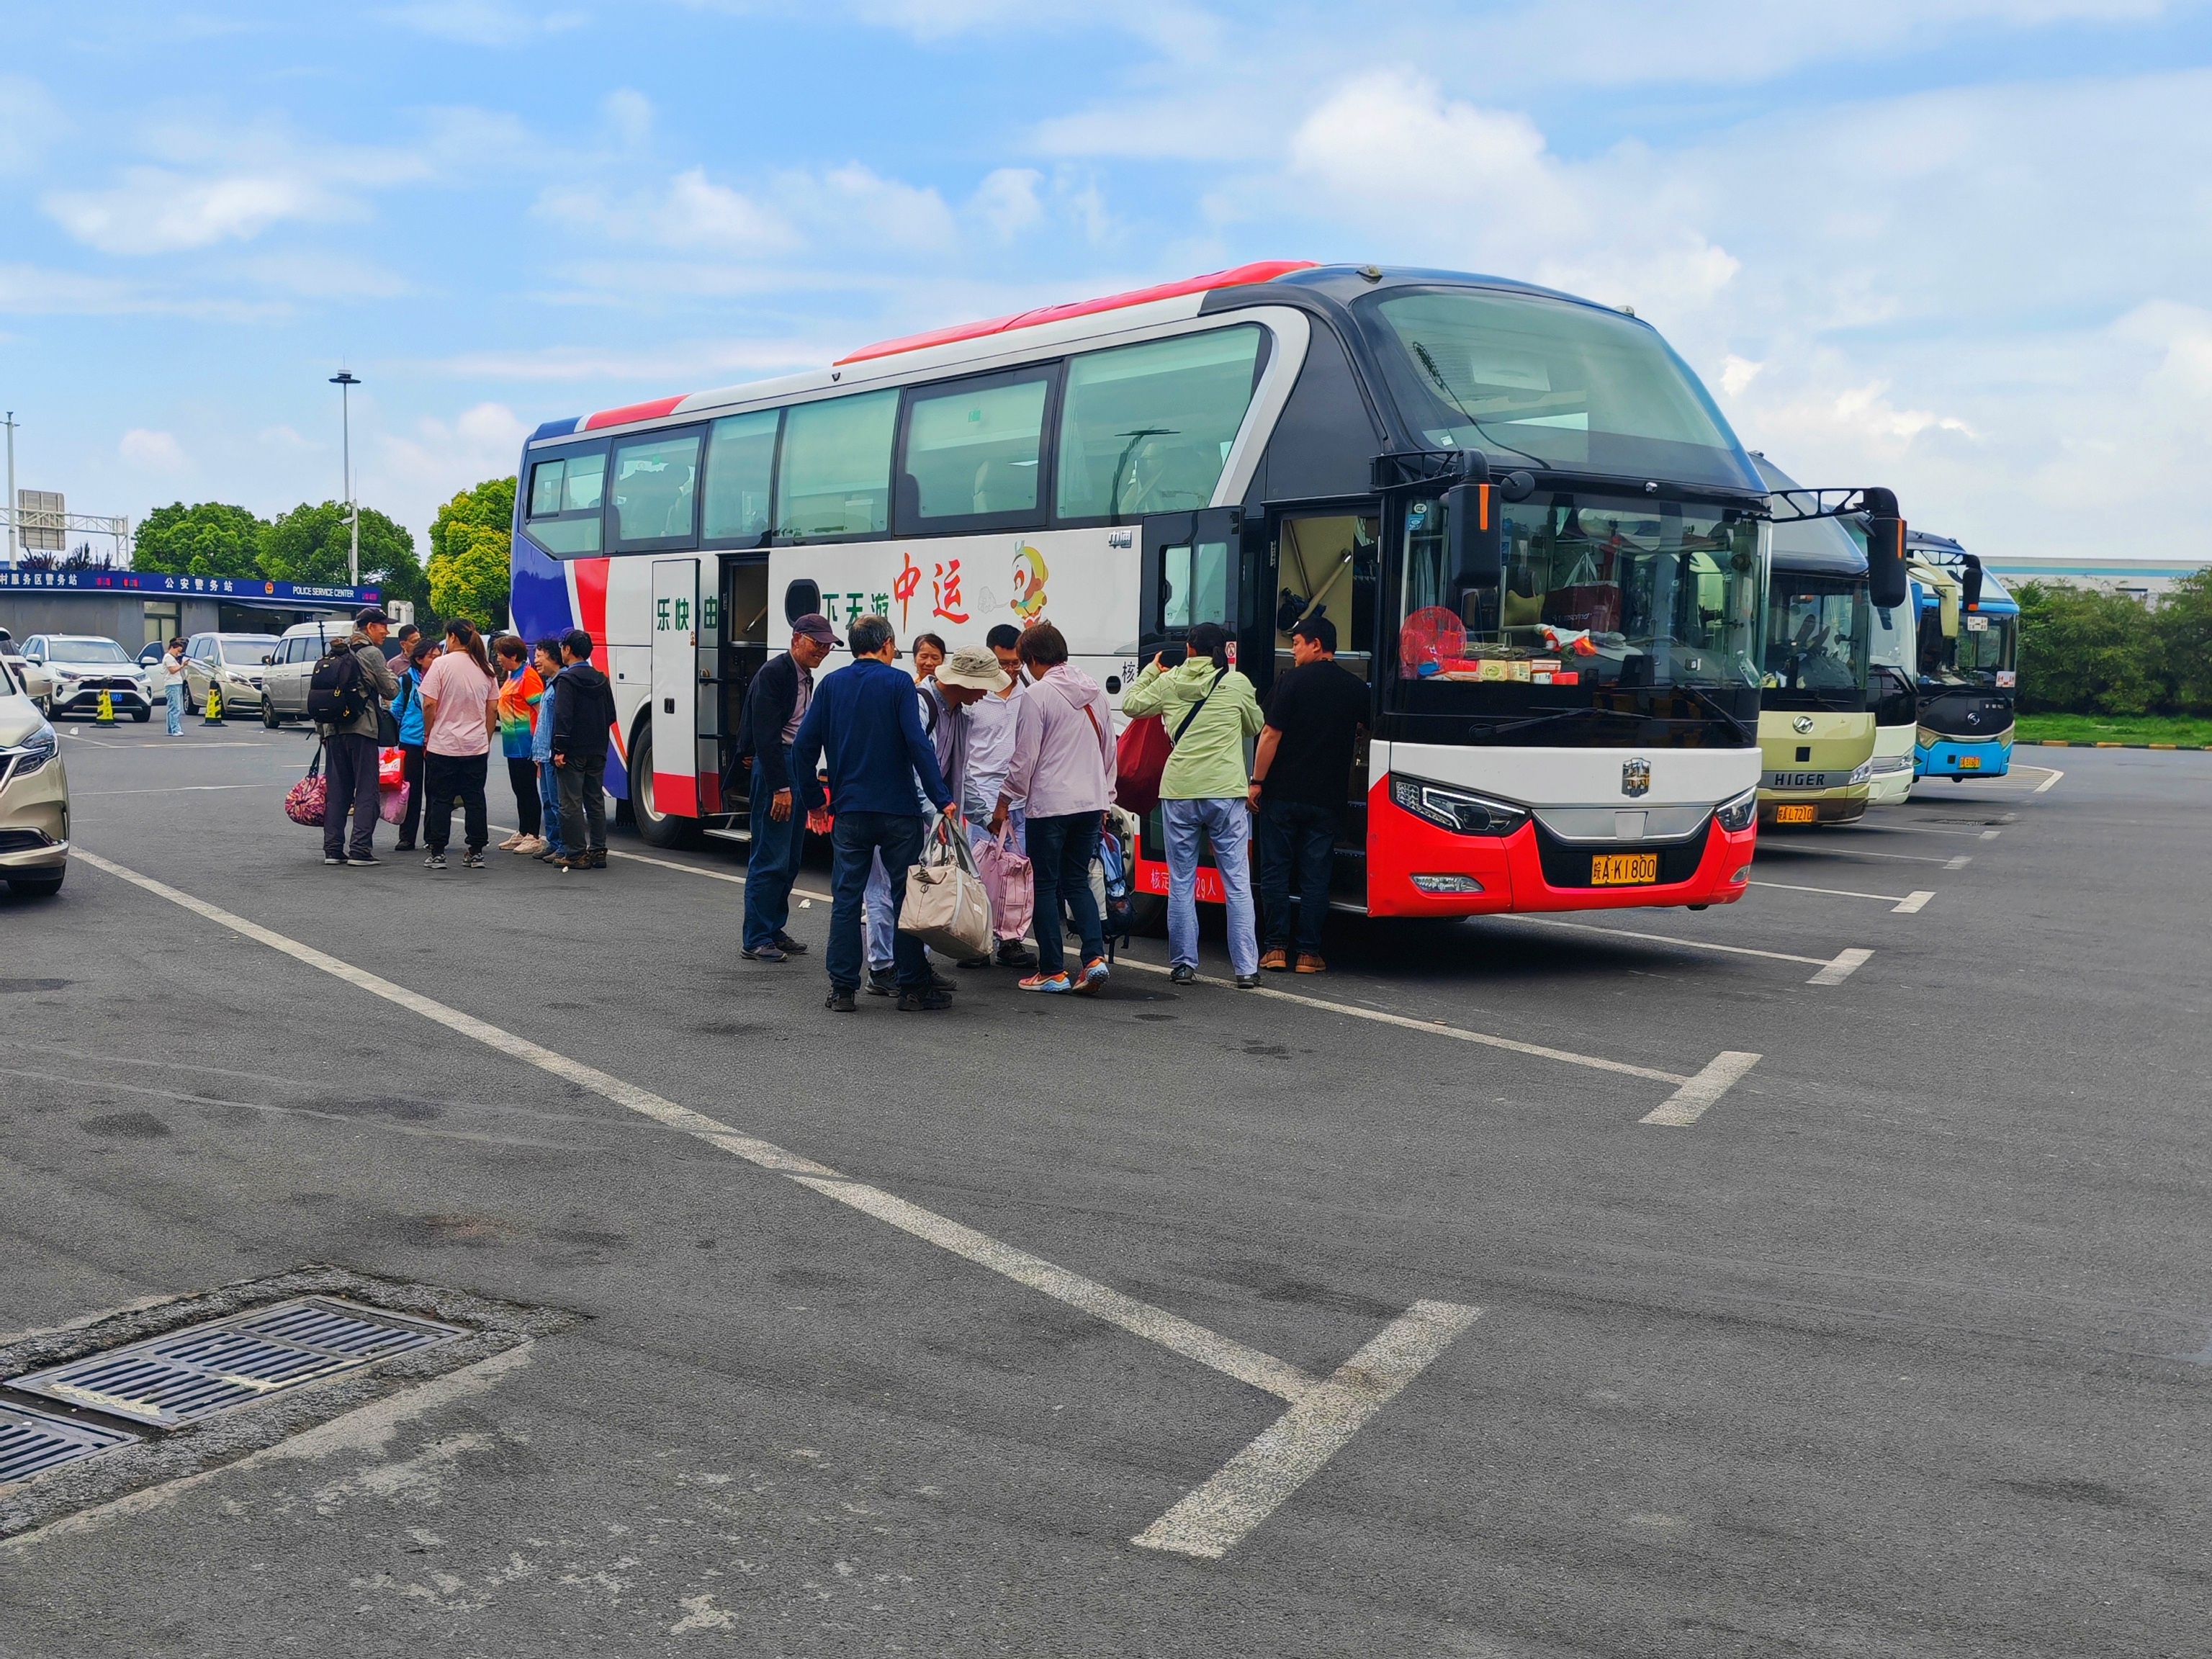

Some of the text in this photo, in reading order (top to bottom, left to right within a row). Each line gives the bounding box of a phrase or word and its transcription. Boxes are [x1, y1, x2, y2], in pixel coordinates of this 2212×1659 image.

[165, 577, 233, 592] 公安警务站
[292, 586, 312, 595] POLICE
[312, 588, 333, 597] SERVICE
[334, 589, 354, 598] CENTER
[1774, 773, 1825, 786] HIGER
